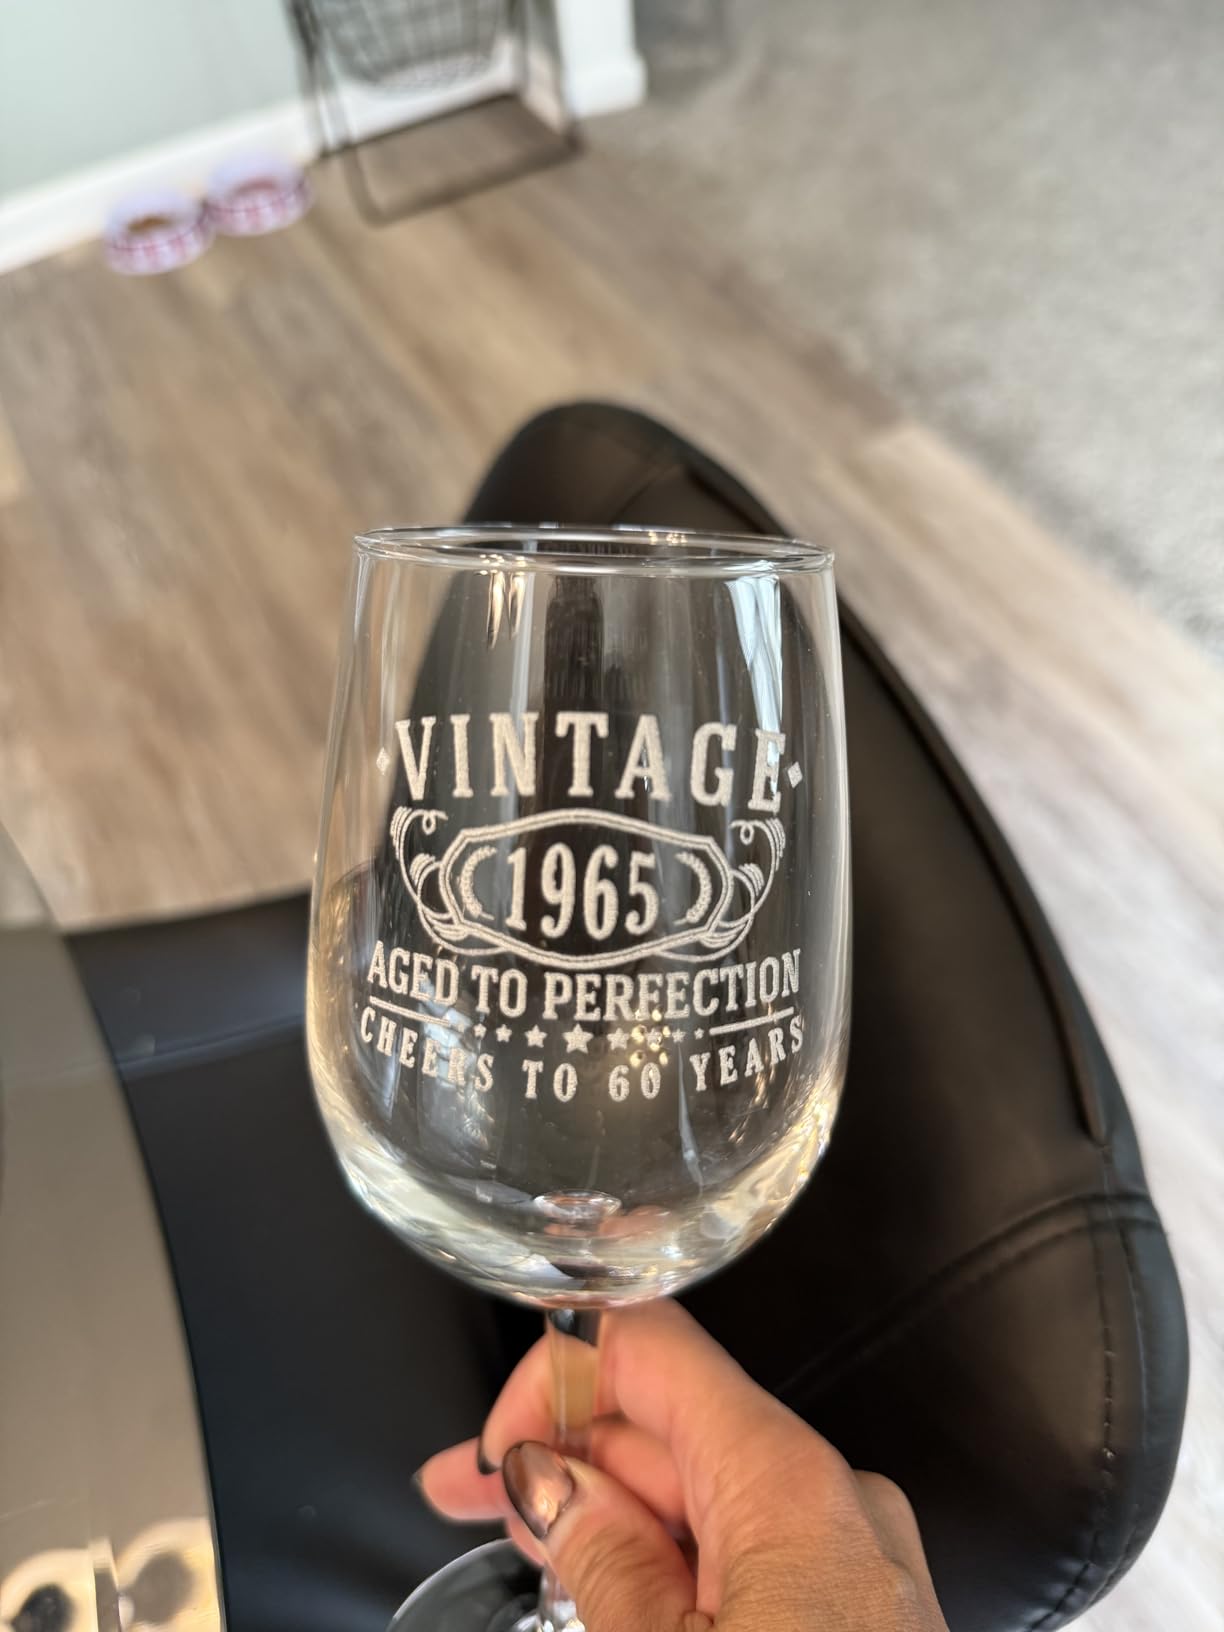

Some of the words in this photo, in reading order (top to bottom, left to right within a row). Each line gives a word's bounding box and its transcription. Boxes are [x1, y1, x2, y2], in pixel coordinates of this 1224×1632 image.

[395, 711, 786, 813] VINTAGE
[506, 842, 660, 940] 1965
[367, 940, 460, 1014] AGED
[471, 964, 528, 1018] TO
[542, 948, 802, 1021] PERFECTION
[359, 1005, 495, 1093] CHEERS
[522, 1060, 578, 1102] TO
[608, 1063, 661, 1102] 60
[689, 1015, 804, 1092] YEARS
